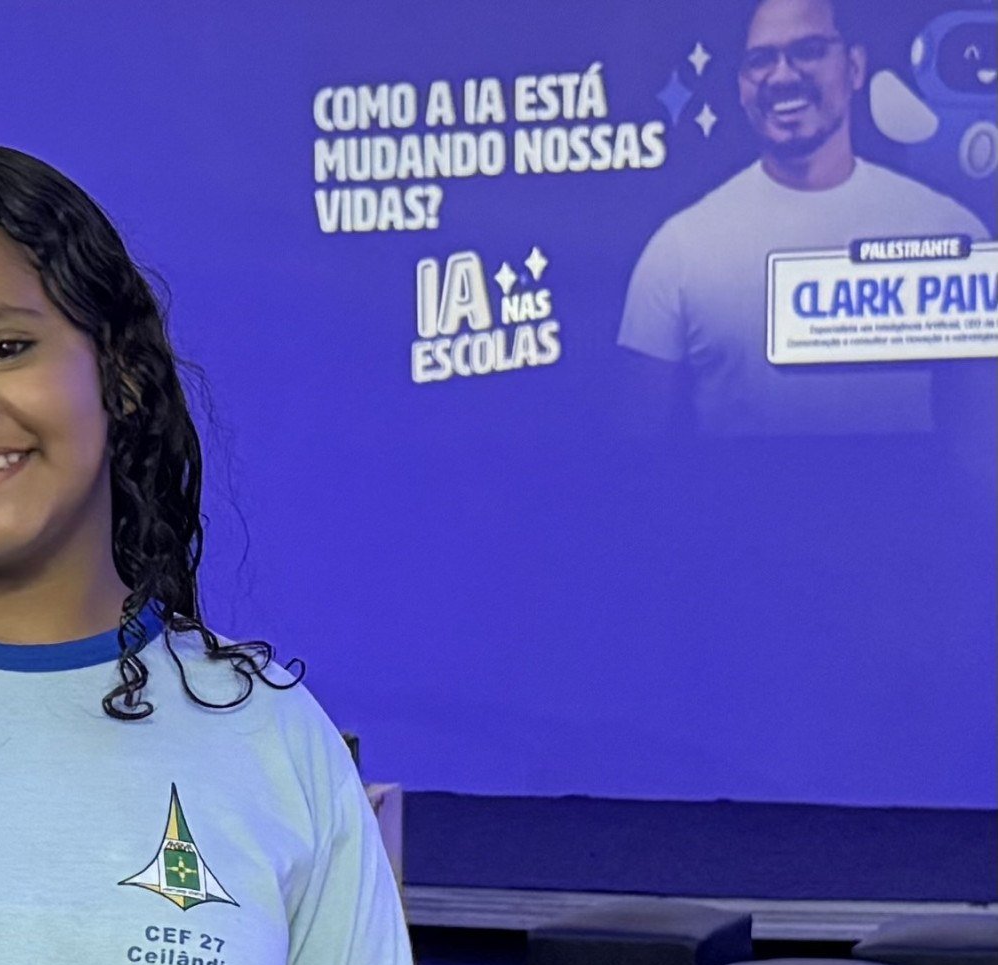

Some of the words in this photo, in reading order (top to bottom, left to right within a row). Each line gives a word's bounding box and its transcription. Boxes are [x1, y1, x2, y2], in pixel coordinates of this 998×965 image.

[314, 83, 417, 131] COMO
[426, 81, 456, 127] A
[463, 78, 506, 124] IA
[514, 62, 608, 120] ESTÁ
[314, 130, 506, 182] MUDANDO
[514, 122, 666, 174] NOSSAS
[314, 185, 443, 233] VIDAS?
[859, 238, 961, 261] PALESTRANTE
[416, 251, 492, 337] IA
[501, 288, 552, 325] NAS
[791, 276, 904, 319] CLARK
[411, 321, 561, 383] ESCOLAS
[144, 925, 192, 945] CEF
[199, 933, 226, 954] 27
